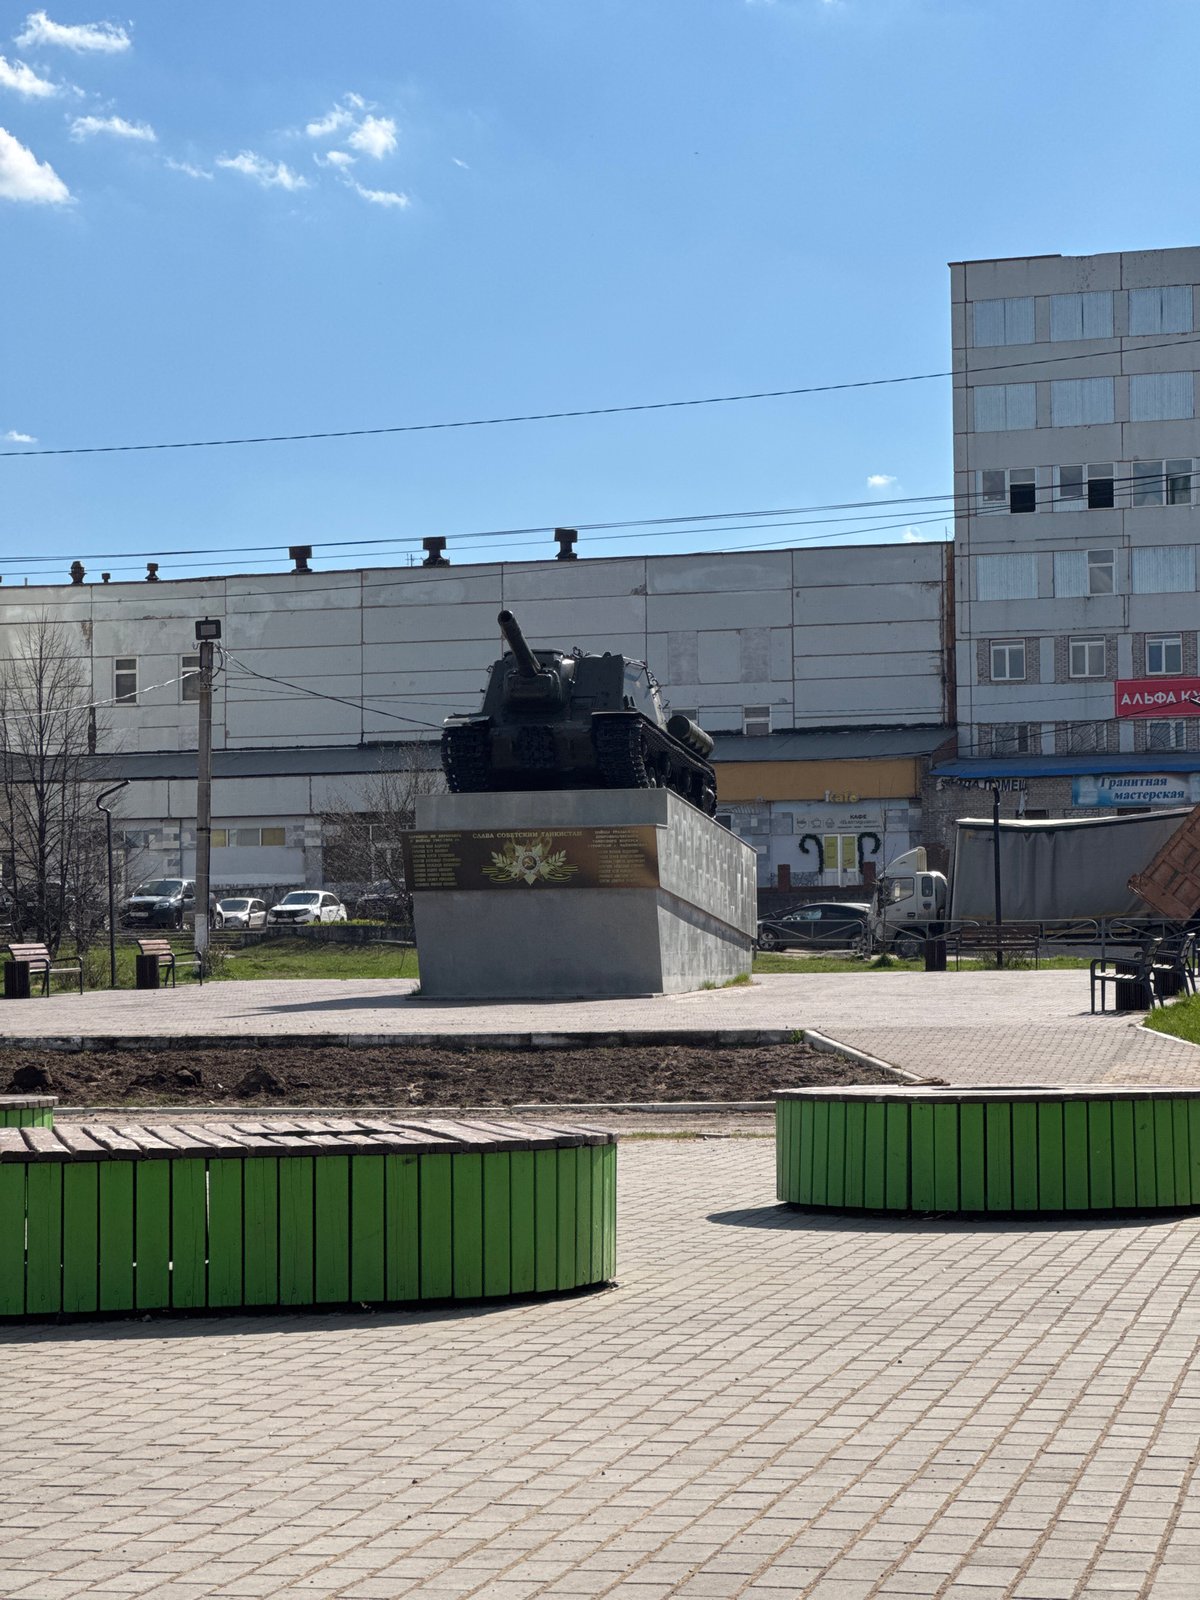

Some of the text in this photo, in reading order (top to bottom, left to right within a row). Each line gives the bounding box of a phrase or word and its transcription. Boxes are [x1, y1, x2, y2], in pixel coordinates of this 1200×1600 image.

[1121, 691, 1176, 705] АЛЬФА
[1101, 777, 1167, 790] Гранитная
[1114, 790, 1184, 801] мастерская
